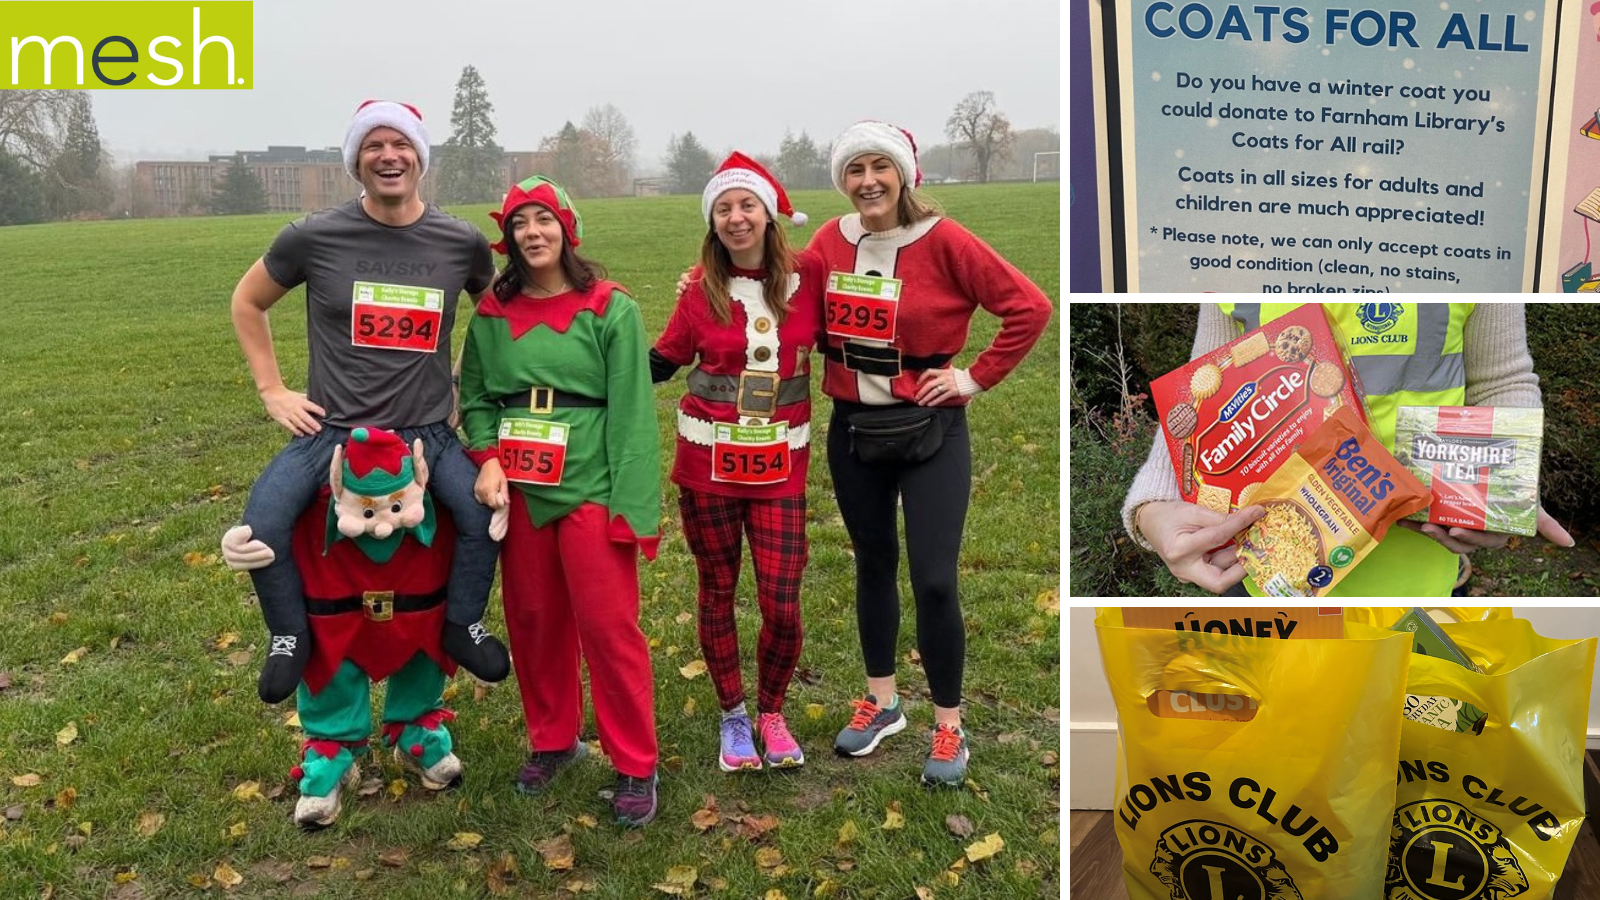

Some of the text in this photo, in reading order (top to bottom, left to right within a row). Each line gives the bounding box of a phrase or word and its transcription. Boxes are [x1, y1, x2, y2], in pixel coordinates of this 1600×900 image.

[1145, 1, 1529, 53] COATS FOR ALL
[1176, 72, 1491, 105] Do you have a winter coat you
[1161, 101, 1506, 135] could donate to Farnham Library's
[1232, 131, 1405, 155] Coats for All rail?
[1178, 166, 1484, 198] Coats in all sizes for adults and
[1175, 194, 1485, 226] children are much appreciated!
[1162, 227, 1512, 260] Please note, we can only accept coats in
[1190, 255, 1461, 284] good condition (clean, no stains,
[1262, 284, 1283, 293] no
[1287, 281, 1347, 293] broken
[358, 313, 433, 341] 5294
[827, 301, 889, 331] 5295
[1351, 334, 1408, 345] LIONS CLUB
[1200, 371, 1304, 472] Family Circle
[1240, 407, 1313, 477] 10 biscuit varieties to enjoy
[1255, 426, 1304, 474] with all the family
[1417, 439, 1513, 465] YORKSHIRE
[503, 448, 554, 474] 5155
[722, 451, 784, 475] 5154
[1334, 436, 1395, 501] Ben's
[1445, 462, 1476, 481] TEA
[1323, 457, 1377, 517] Original
[1300, 485, 1340, 534] WHOLEGRAIN
[1324, 494, 1360, 535] VEGETABLE
[1313, 570, 1326, 582] 2
[1119, 771, 1339, 863] LIONS CLUB
[1404, 804, 1494, 841] LIONS
[1462, 774, 1562, 842] CLUB
[1169, 825, 1266, 864] LIONS
[1425, 840, 1466, 892] L
